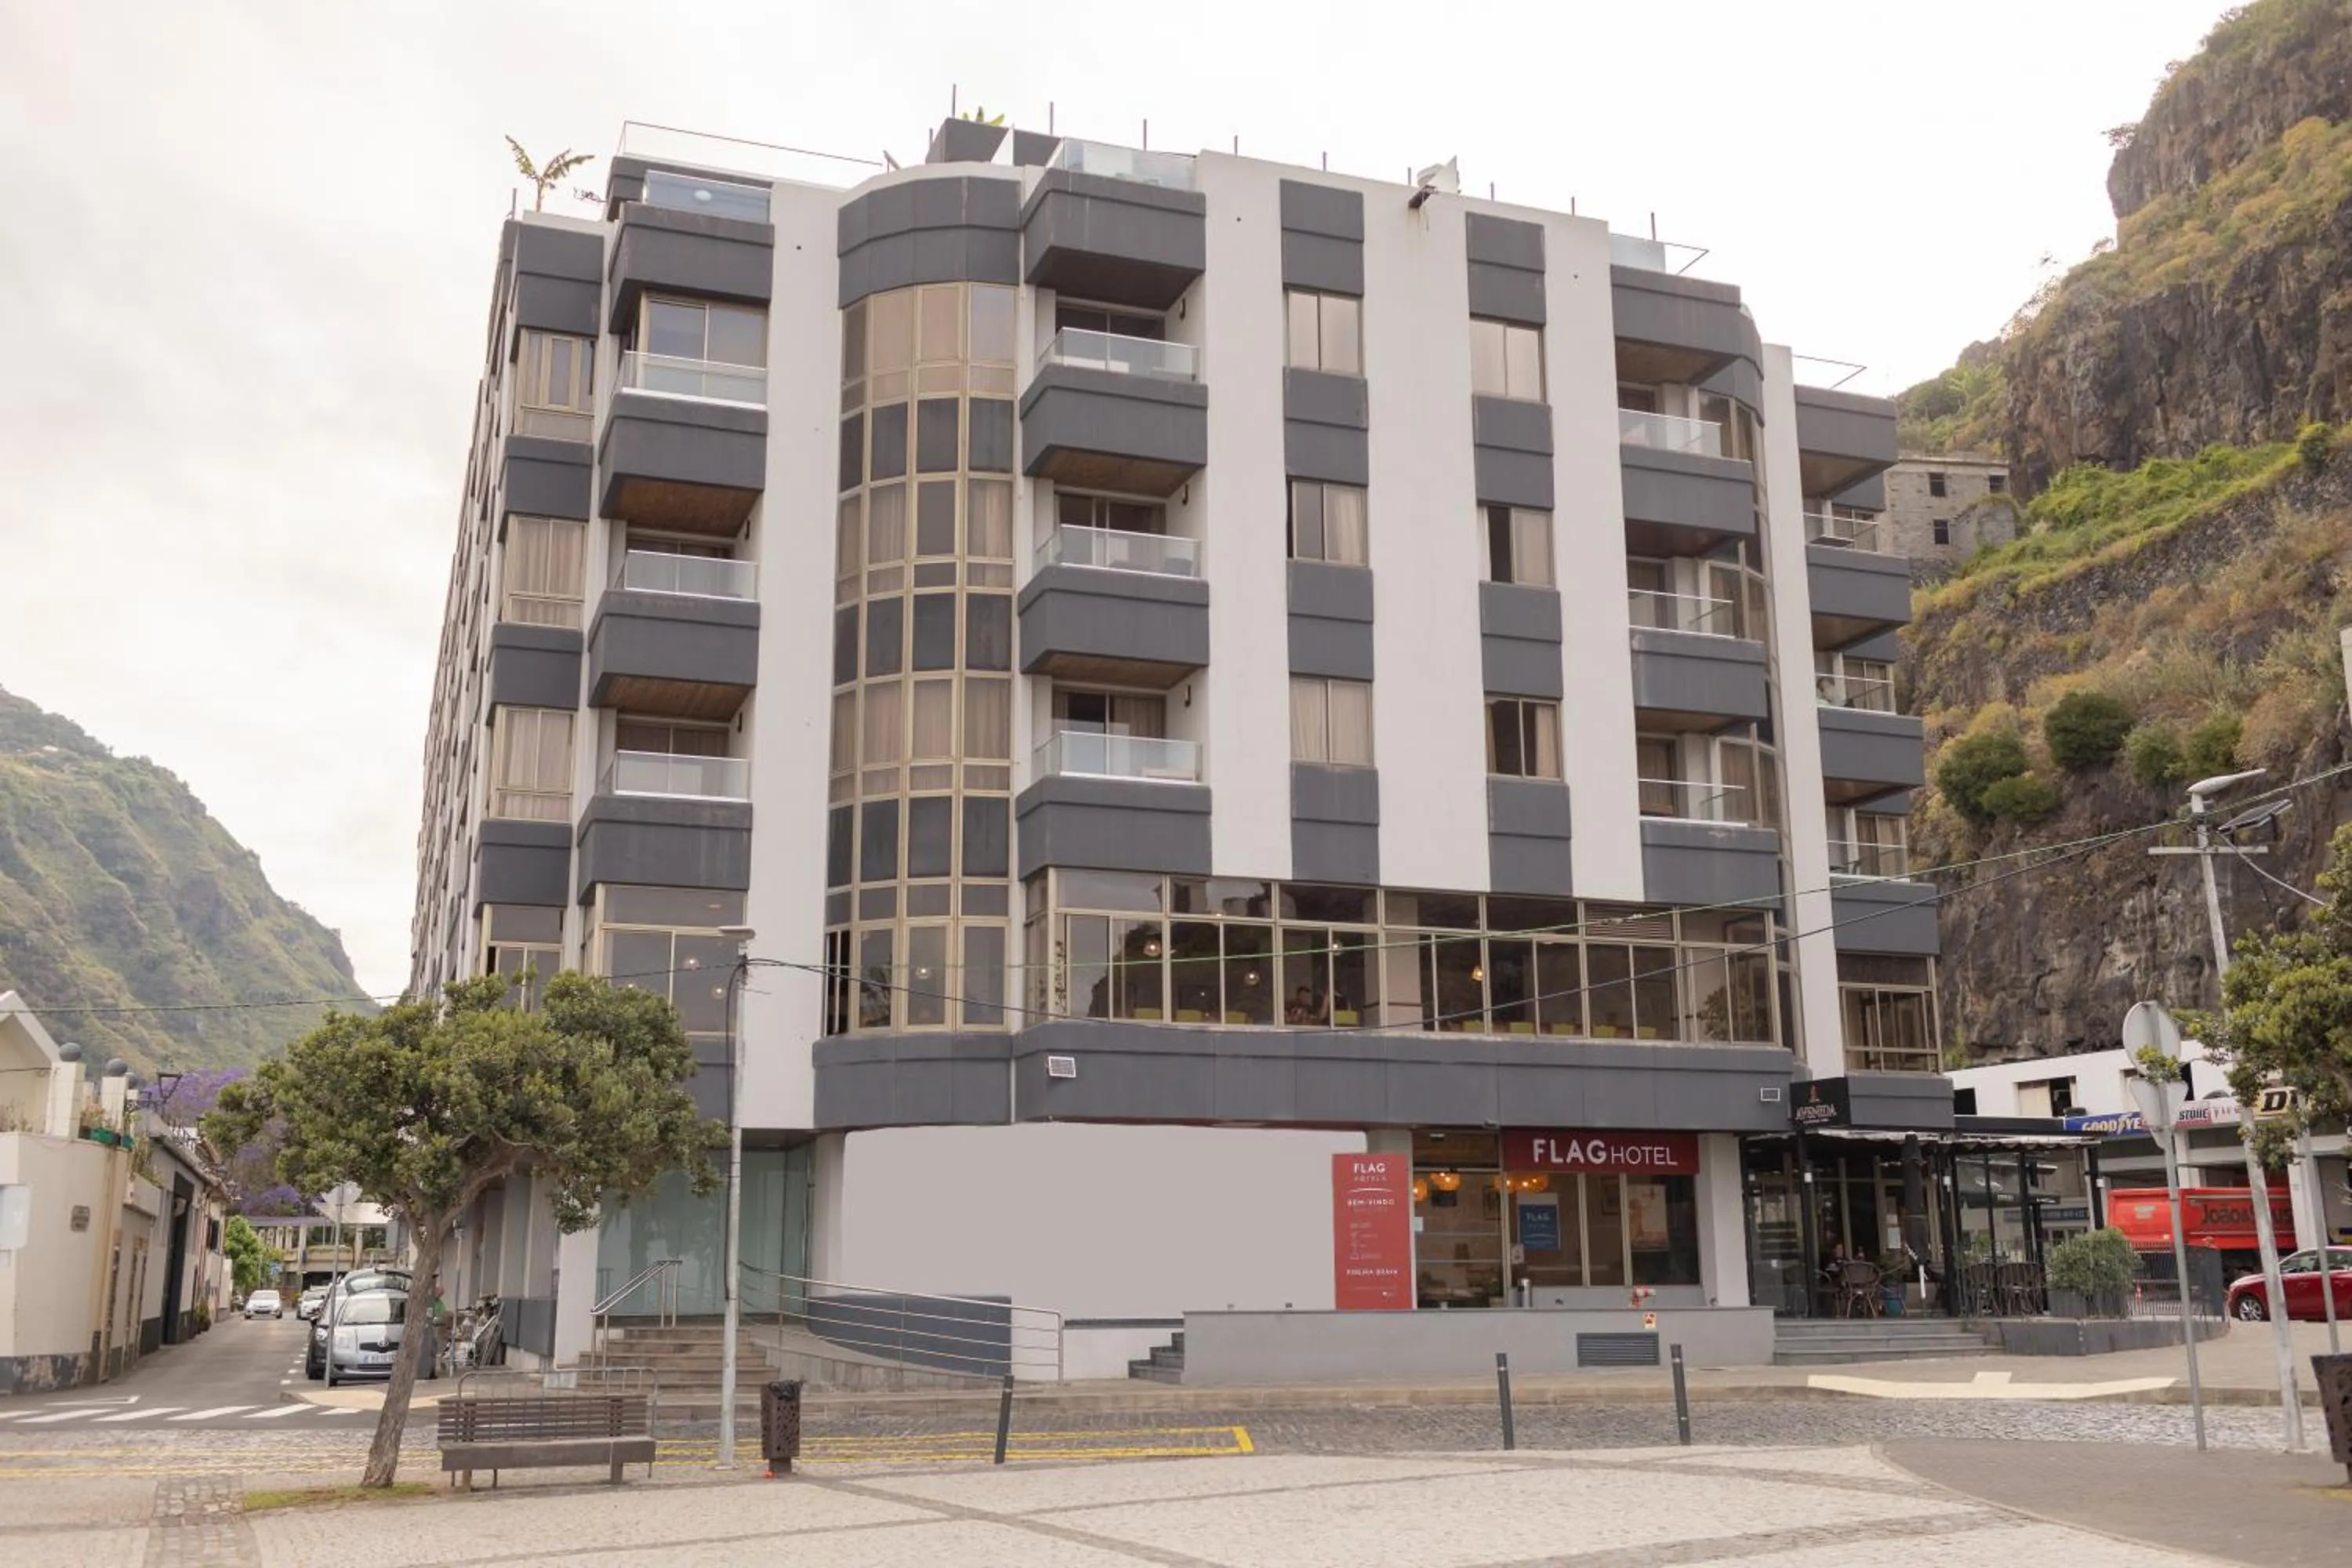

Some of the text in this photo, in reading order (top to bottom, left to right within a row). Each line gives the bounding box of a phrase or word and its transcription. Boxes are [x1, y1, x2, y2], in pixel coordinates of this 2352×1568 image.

[2082, 1115, 2148, 1134] GOODYE
[1533, 1139, 1679, 1166] FLAG HOTEL
[1354, 1162, 1386, 1174] FLAG
